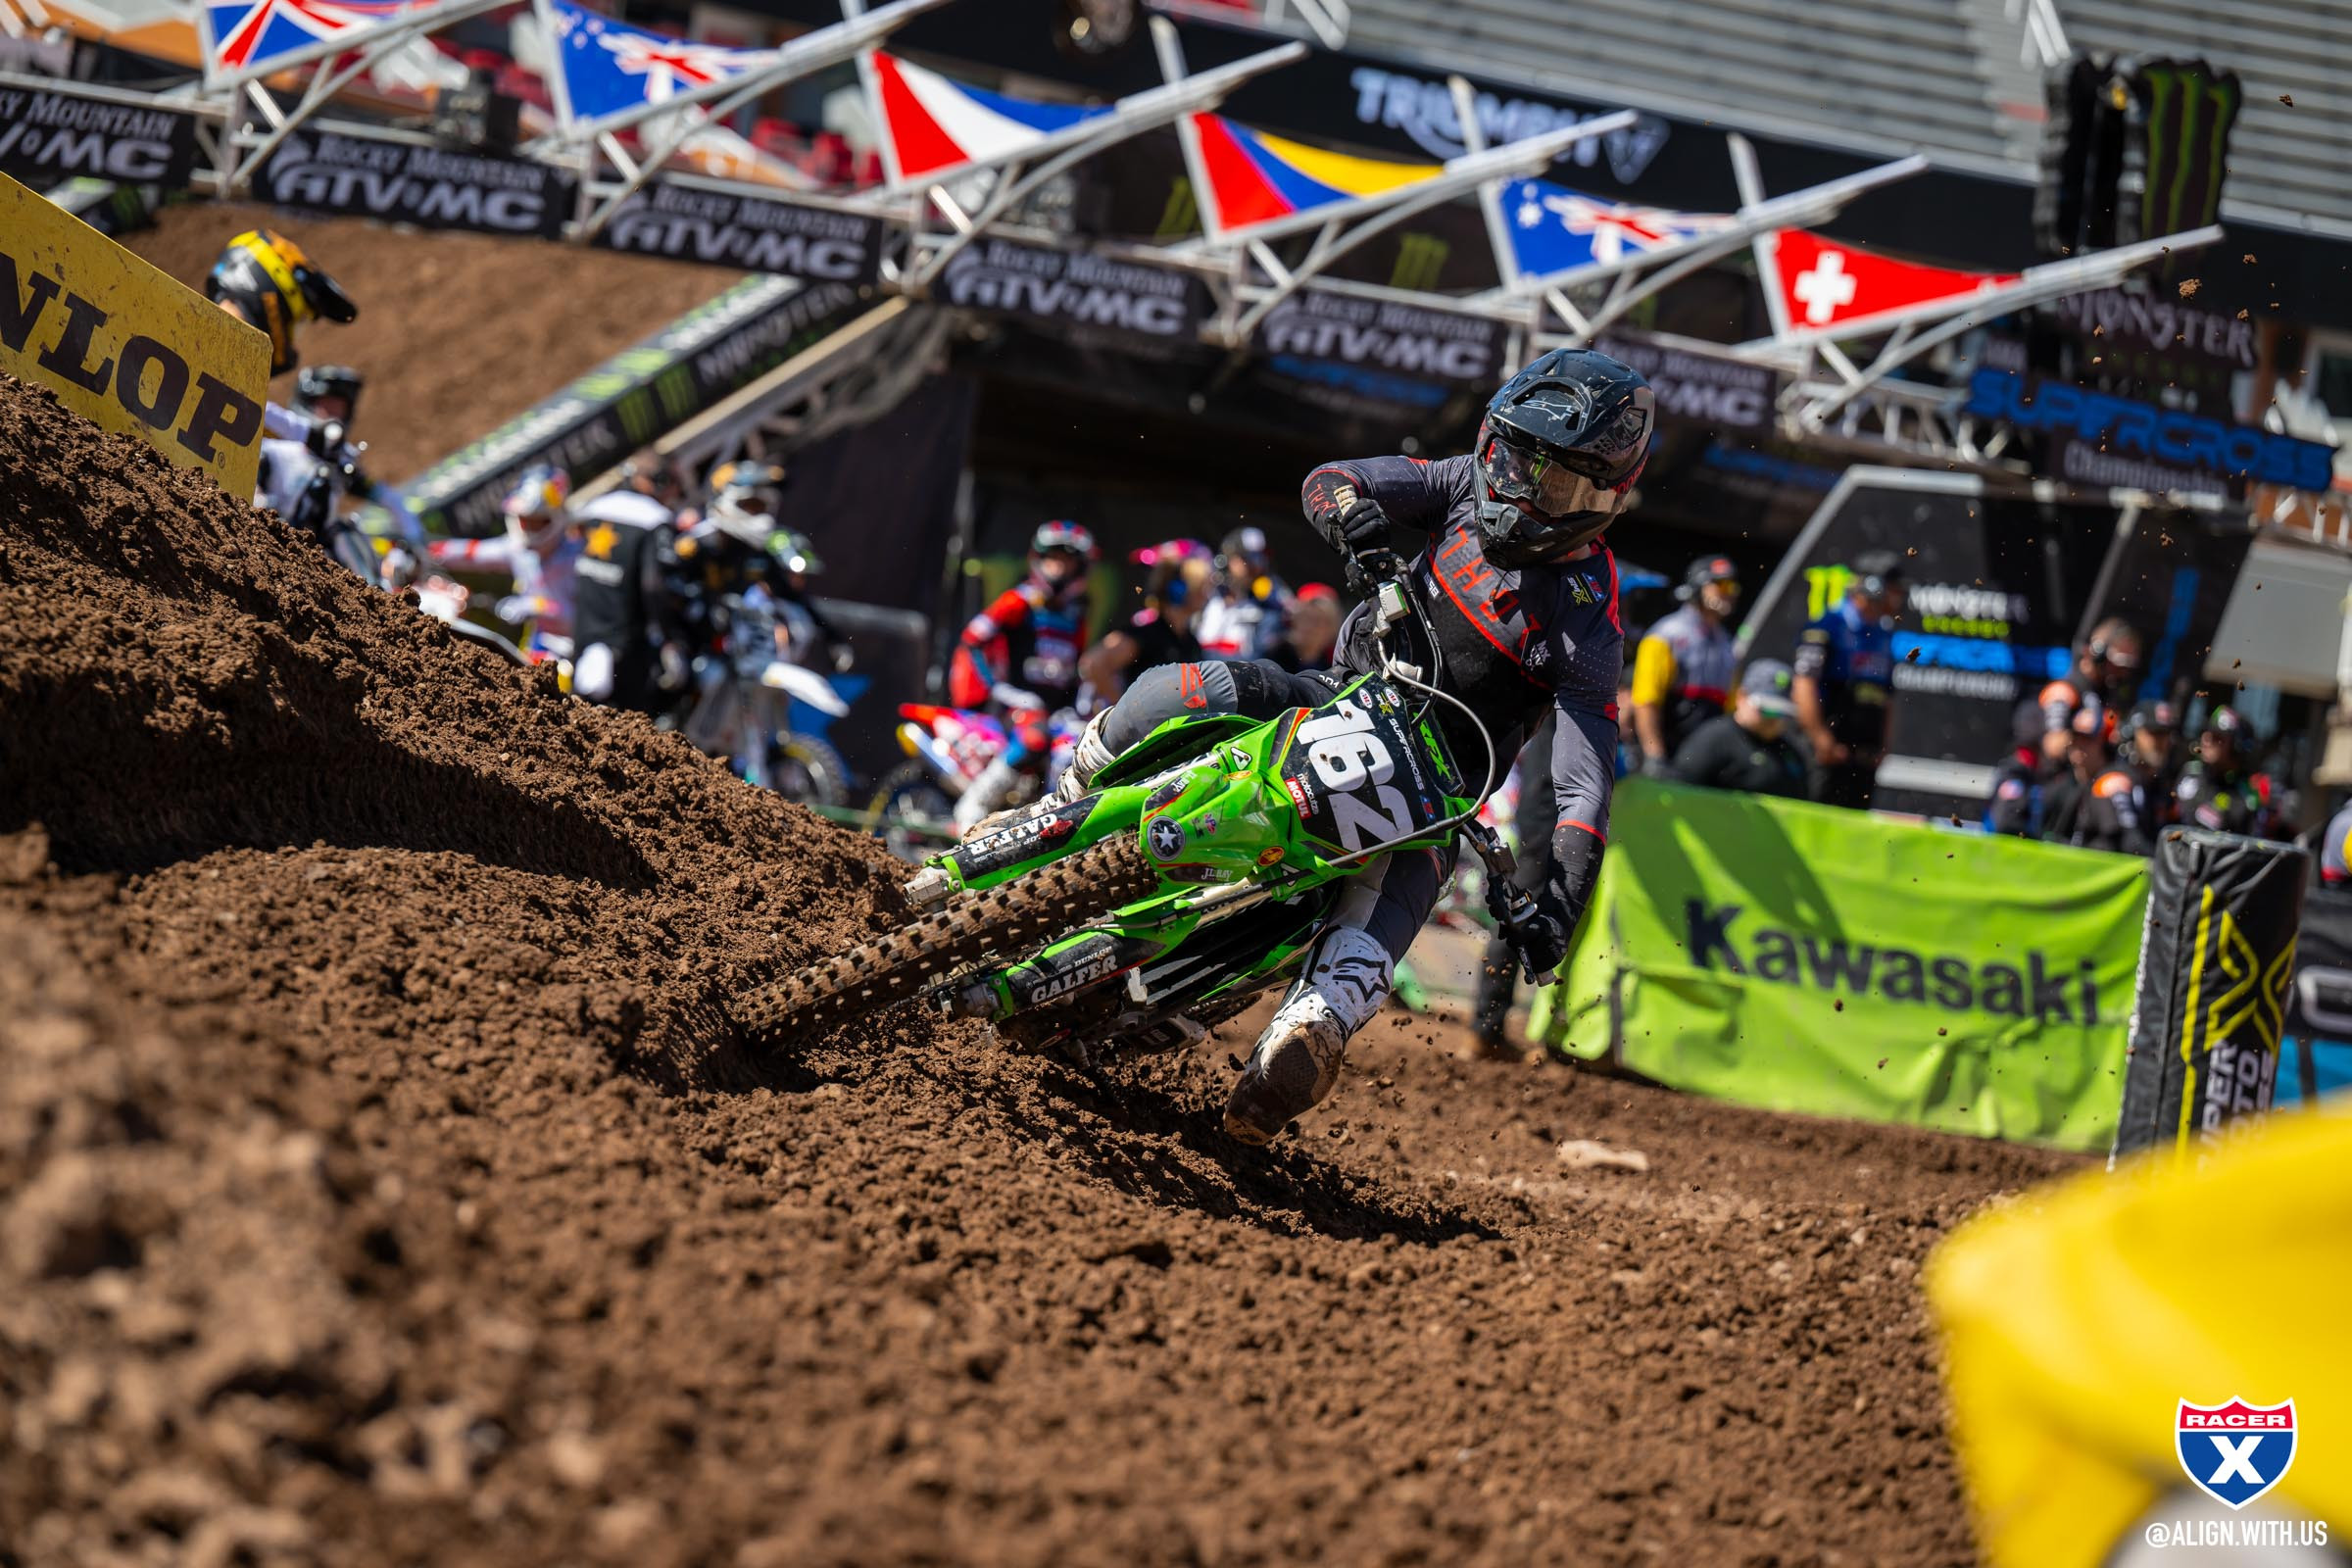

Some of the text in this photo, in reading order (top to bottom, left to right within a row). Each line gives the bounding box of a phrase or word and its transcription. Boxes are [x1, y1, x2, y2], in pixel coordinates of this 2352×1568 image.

[26, 93, 177, 140] MOUNTAIN
[1287, 780, 1309, 819] MOTUL
[1297, 699, 1414, 853] 162
[967, 812, 1057, 856] GALFER
[1031, 955, 1117, 1004] GALFER
[1684, 896, 2102, 1027] Kawasaki
